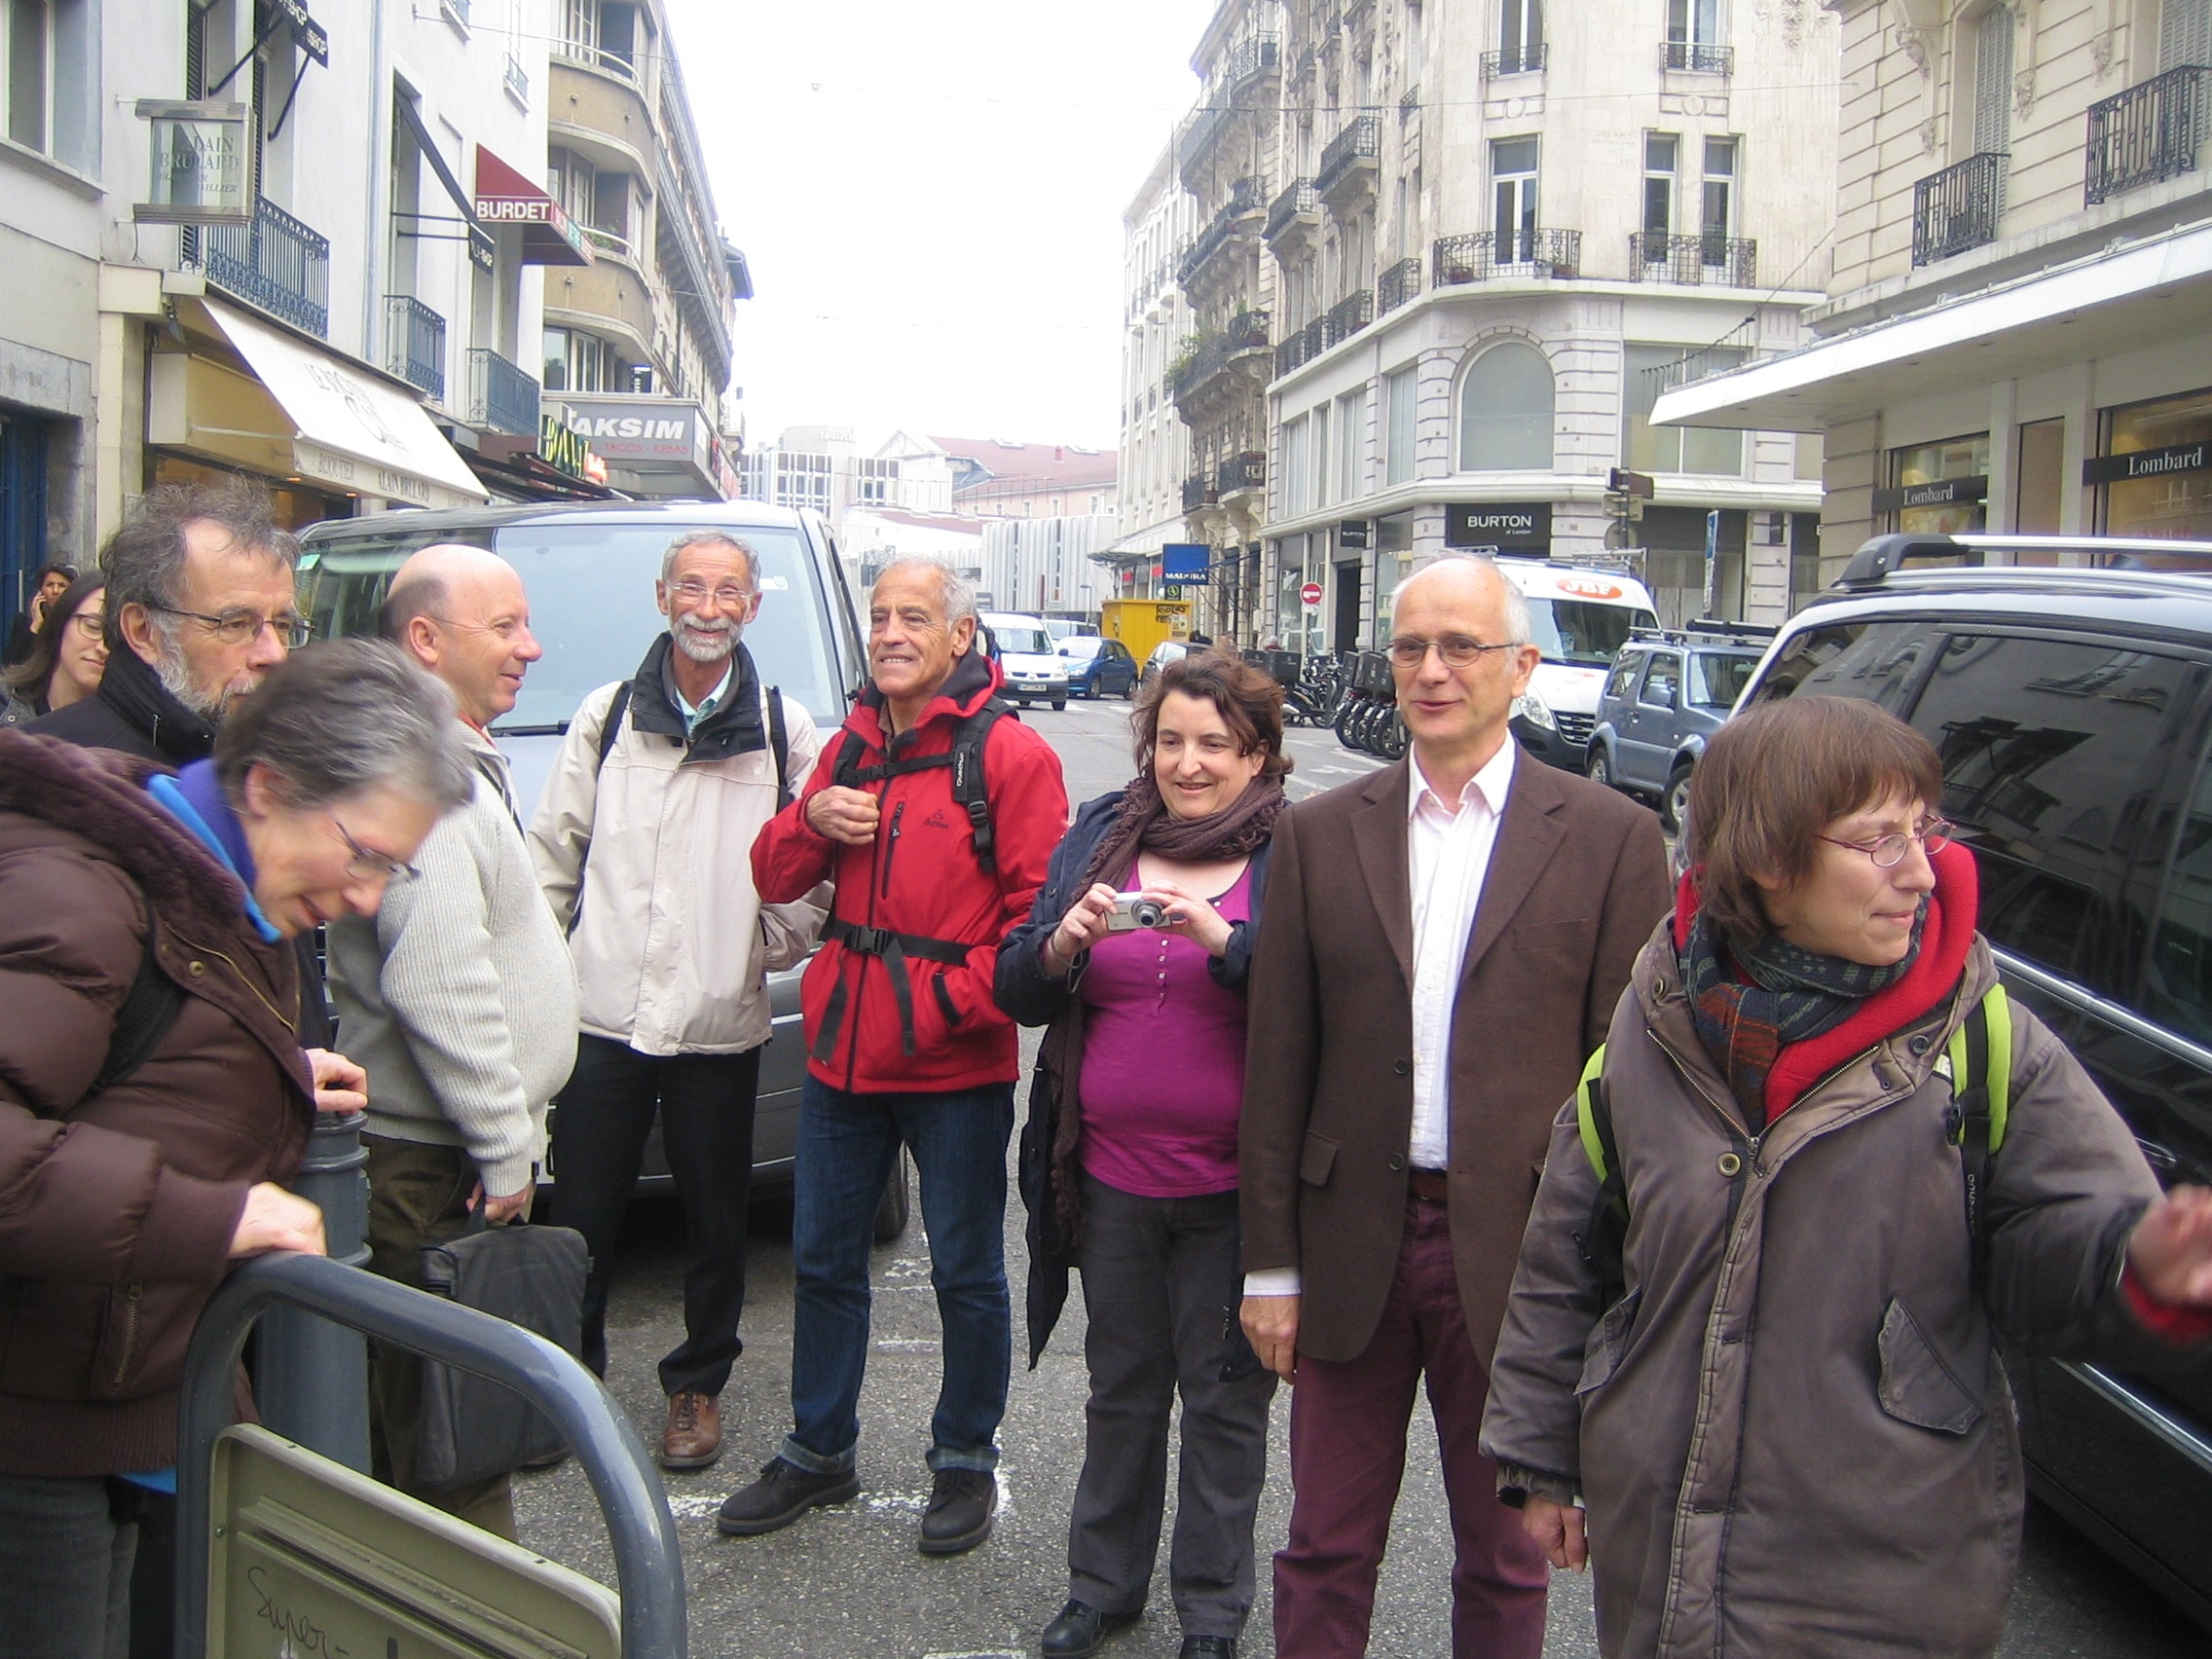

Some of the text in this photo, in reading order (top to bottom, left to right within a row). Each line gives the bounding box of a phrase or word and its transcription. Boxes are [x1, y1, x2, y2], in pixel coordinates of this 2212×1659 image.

[476, 202, 549, 220] BURDET
[2128, 447, 2202, 476] Lombard
[1903, 484, 1953, 505] Lombard
[1467, 514, 1531, 528] BURTON
